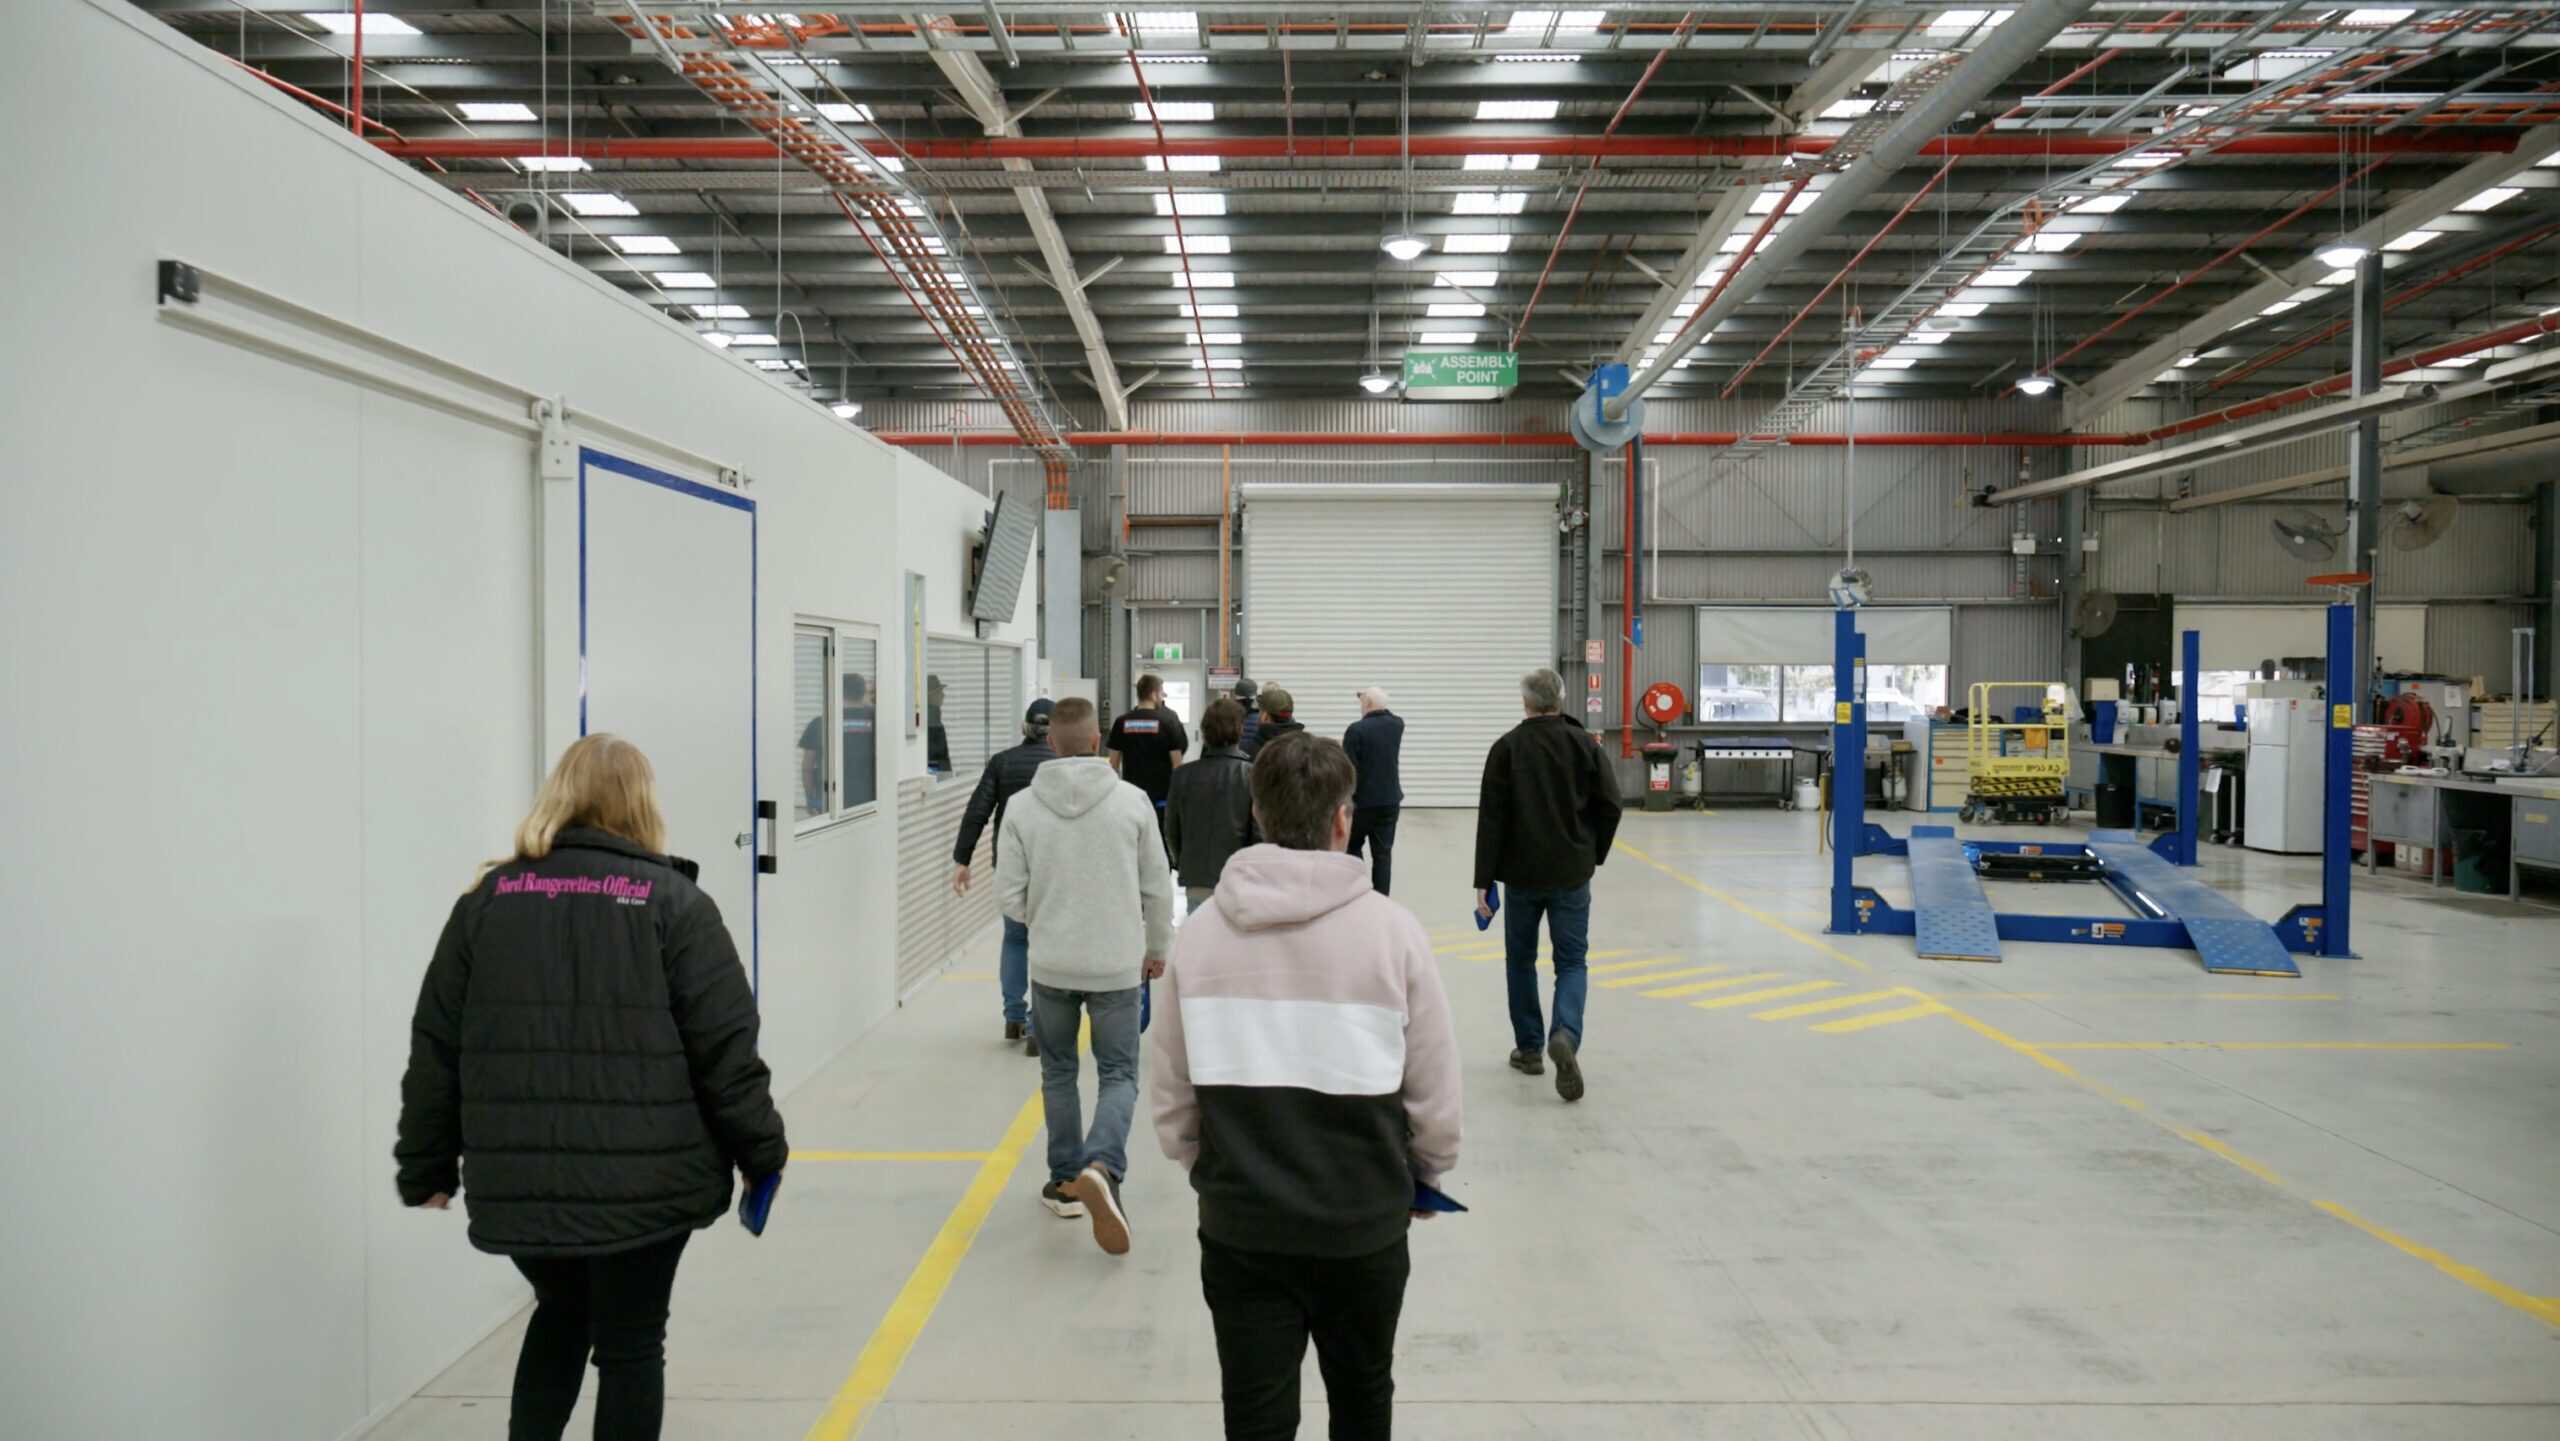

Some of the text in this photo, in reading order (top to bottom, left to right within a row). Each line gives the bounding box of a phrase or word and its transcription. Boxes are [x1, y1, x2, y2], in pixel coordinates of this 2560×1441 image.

[1440, 355, 1515, 369] ASSEMBLY
[1456, 370, 1499, 383] POINT
[524, 872, 601, 898] Rangerettes
[602, 875, 652, 898] Official
